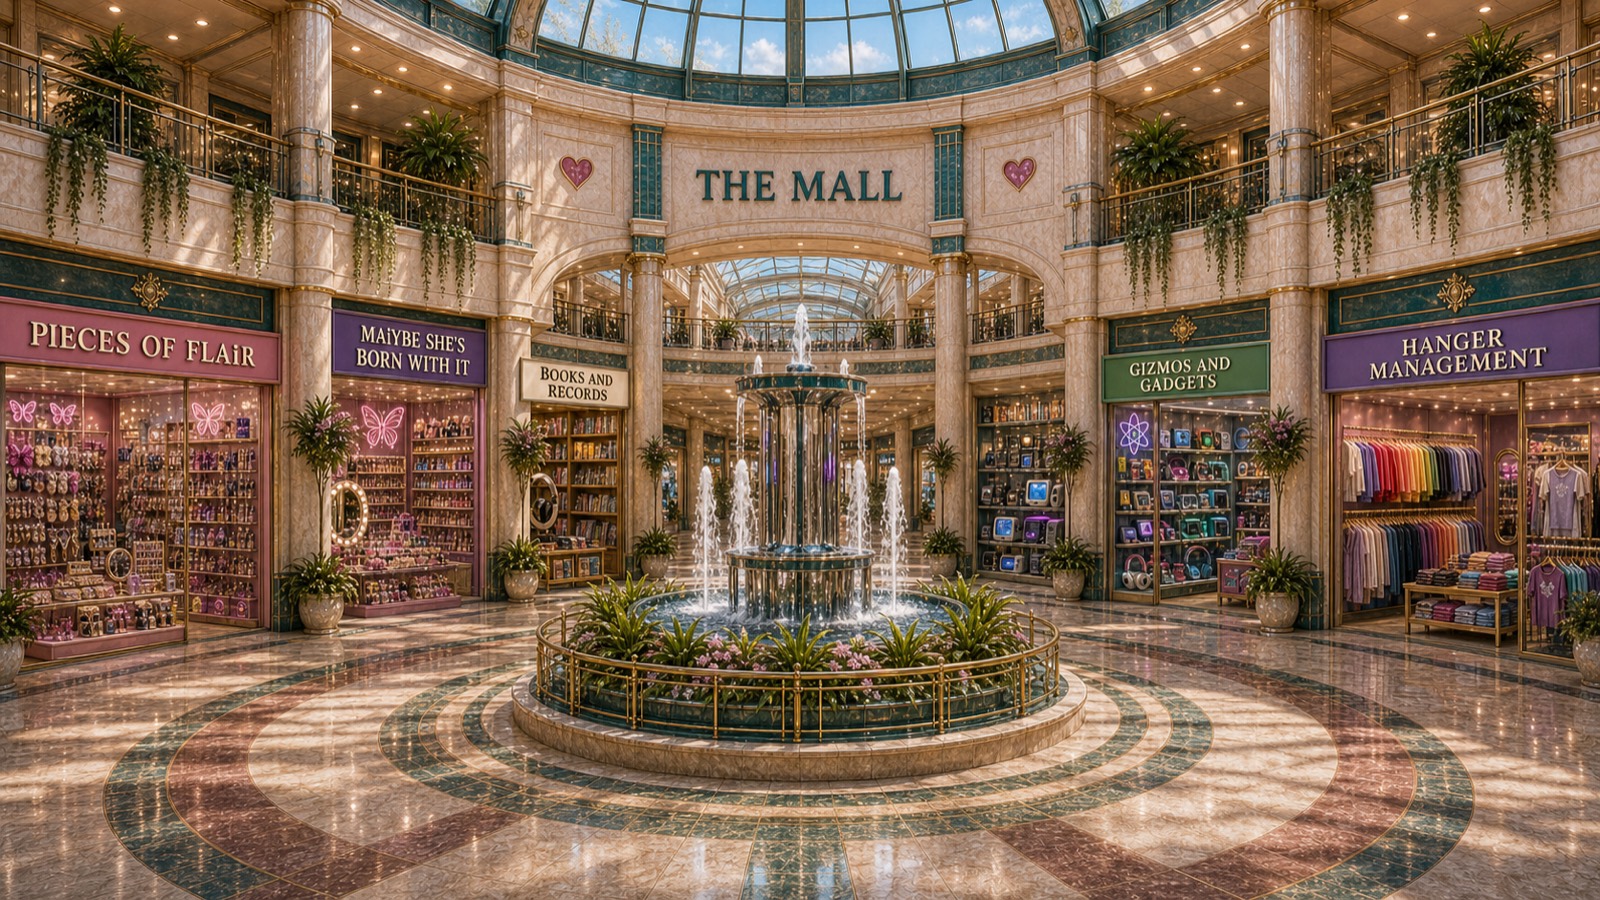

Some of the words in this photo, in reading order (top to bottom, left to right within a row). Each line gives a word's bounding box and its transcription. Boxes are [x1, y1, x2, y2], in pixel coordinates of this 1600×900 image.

[696, 169, 775, 201] THE
[791, 170, 903, 201] MALL
[30, 321, 130, 355] PIECES
[141, 335, 176, 359] OF
[186, 339, 256, 367] FLAiR
[361, 325, 421, 349] MAiYBE
[425, 333, 465, 353] SHE'S
[1402, 328, 1503, 357] HANGER
[356, 348, 402, 369] BORN
[408, 354, 450, 374] WITH
[455, 359, 470, 376] IT
[540, 366, 585, 384] BOOKS
[588, 373, 613, 386] AND
[1129, 359, 1191, 377] GIZMOS
[1197, 356, 1231, 372] AND
[1370, 347, 1547, 380] MANAGEMENT
[548, 384, 608, 401] RECORDS
[1140, 374, 1217, 392] GADGETS
